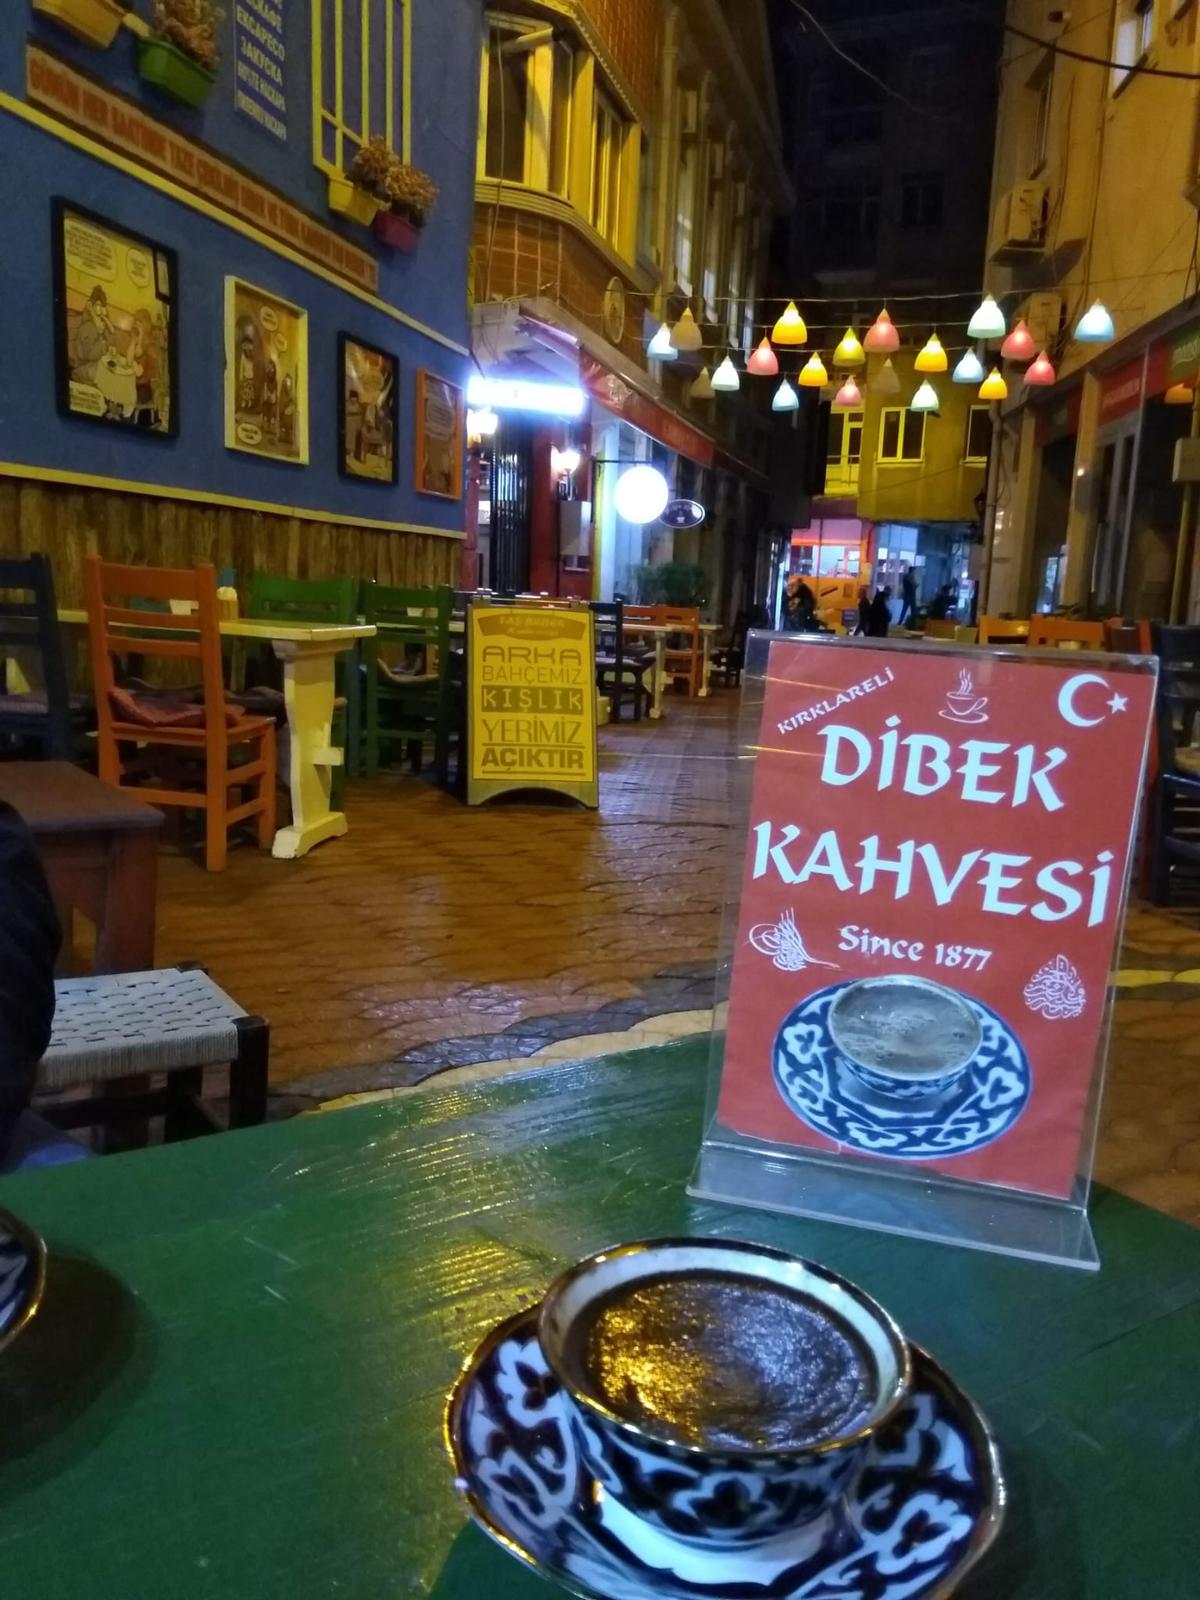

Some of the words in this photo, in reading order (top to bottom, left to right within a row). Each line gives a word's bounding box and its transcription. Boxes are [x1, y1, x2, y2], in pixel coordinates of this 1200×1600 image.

[482, 645, 582, 666] ARKA
[482, 665, 583, 685] BAHÇEMİZ
[483, 687, 582, 713] KIŞLIK
[777, 666, 895, 735] KIRKLARELİ
[482, 715, 583, 744] YERİMİZ
[481, 748, 583, 772] AÇIKTIR
[817, 715, 1068, 812] DİBEK
[753, 820, 1115, 928] KAHVESİ
[837, 924, 925, 962] Since
[934, 943, 993, 972] 1877
